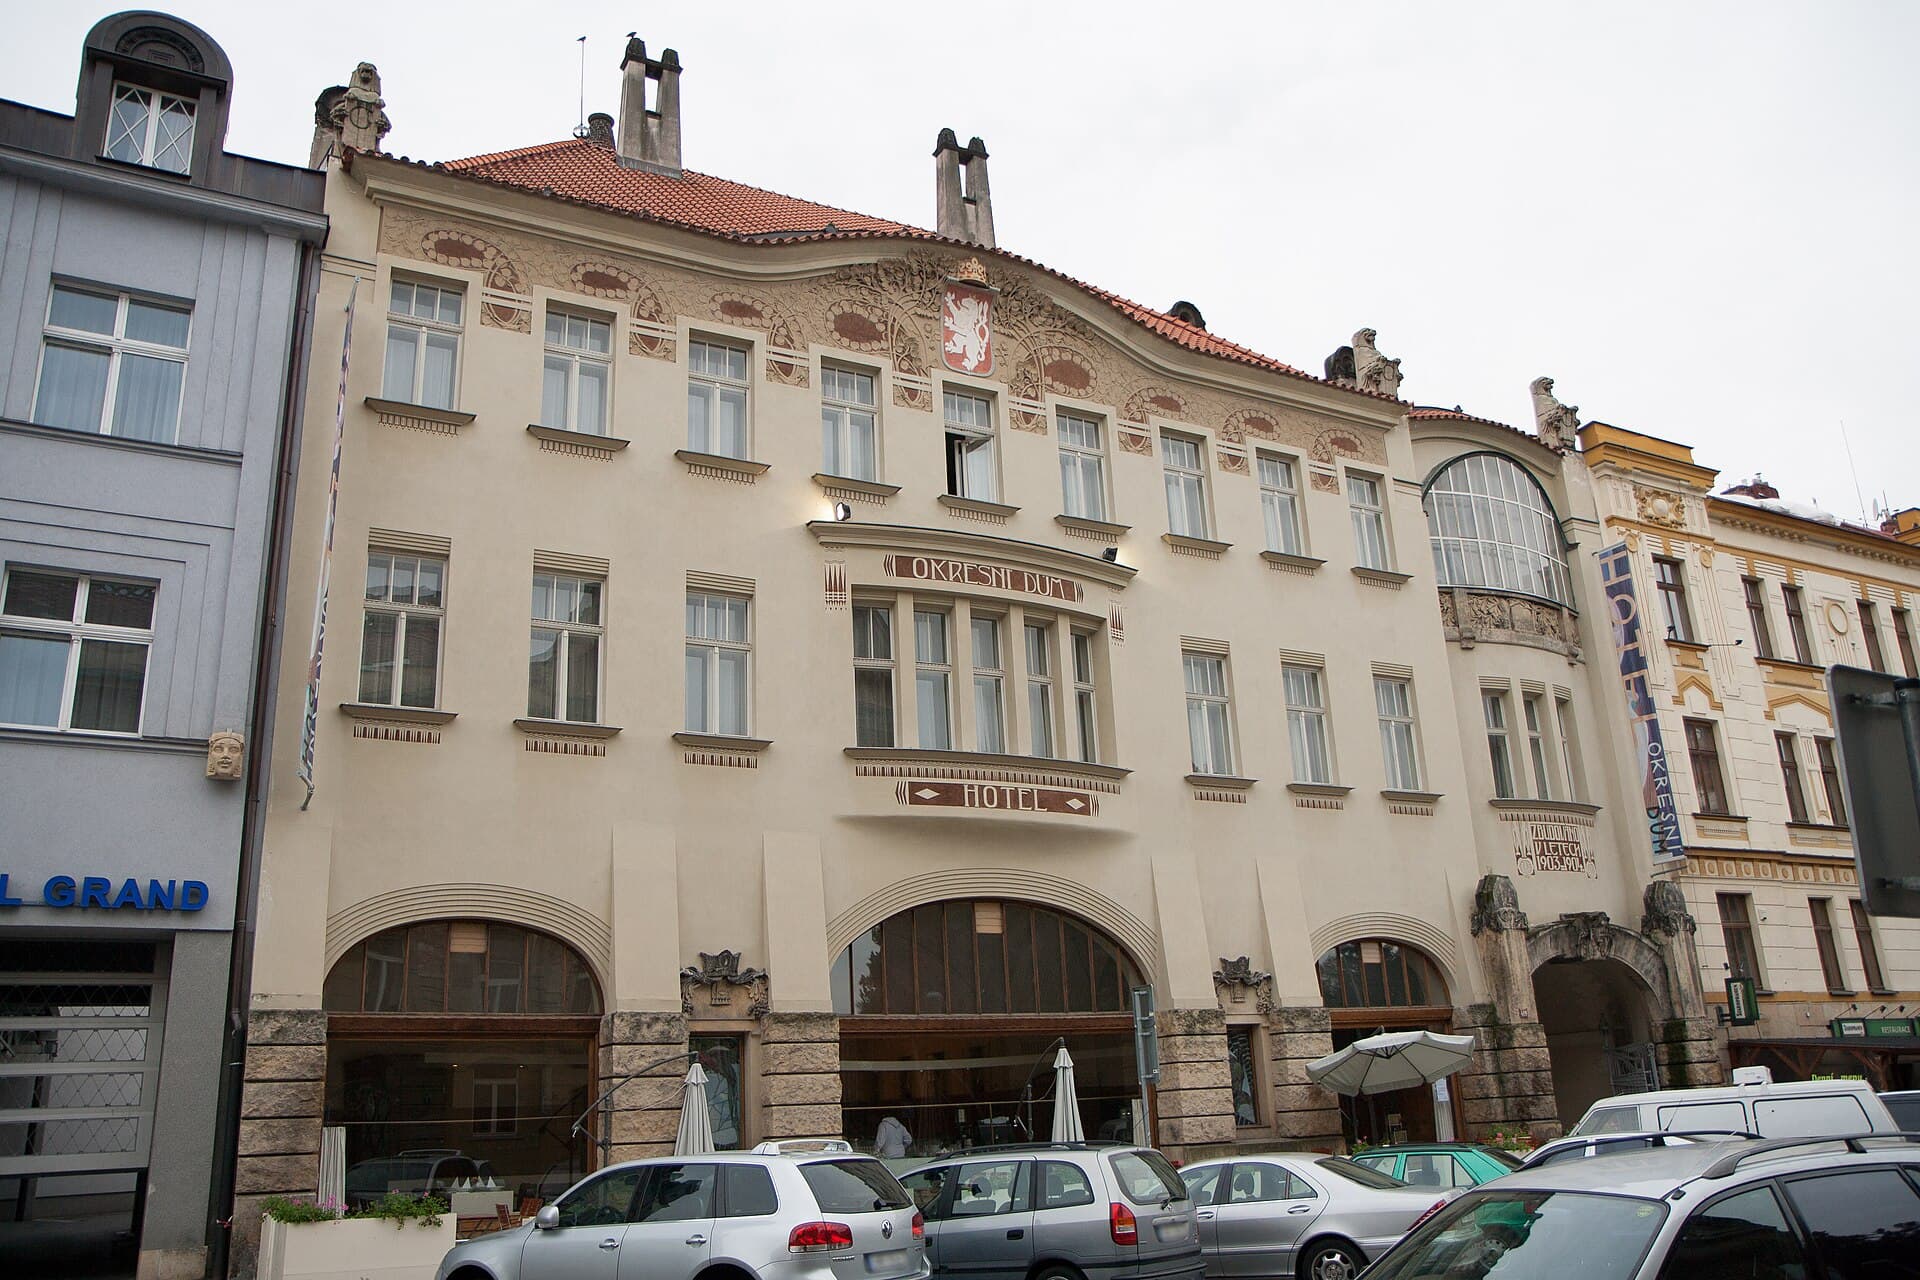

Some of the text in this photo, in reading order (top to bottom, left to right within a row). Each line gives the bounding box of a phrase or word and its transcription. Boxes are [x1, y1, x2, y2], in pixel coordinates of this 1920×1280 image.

[1599, 549, 1658, 747] HOTEL
[963, 784, 1048, 812] HOTEL
[1534, 841, 1582, 858] V LETECH
[43, 875, 210, 912] GRAND
